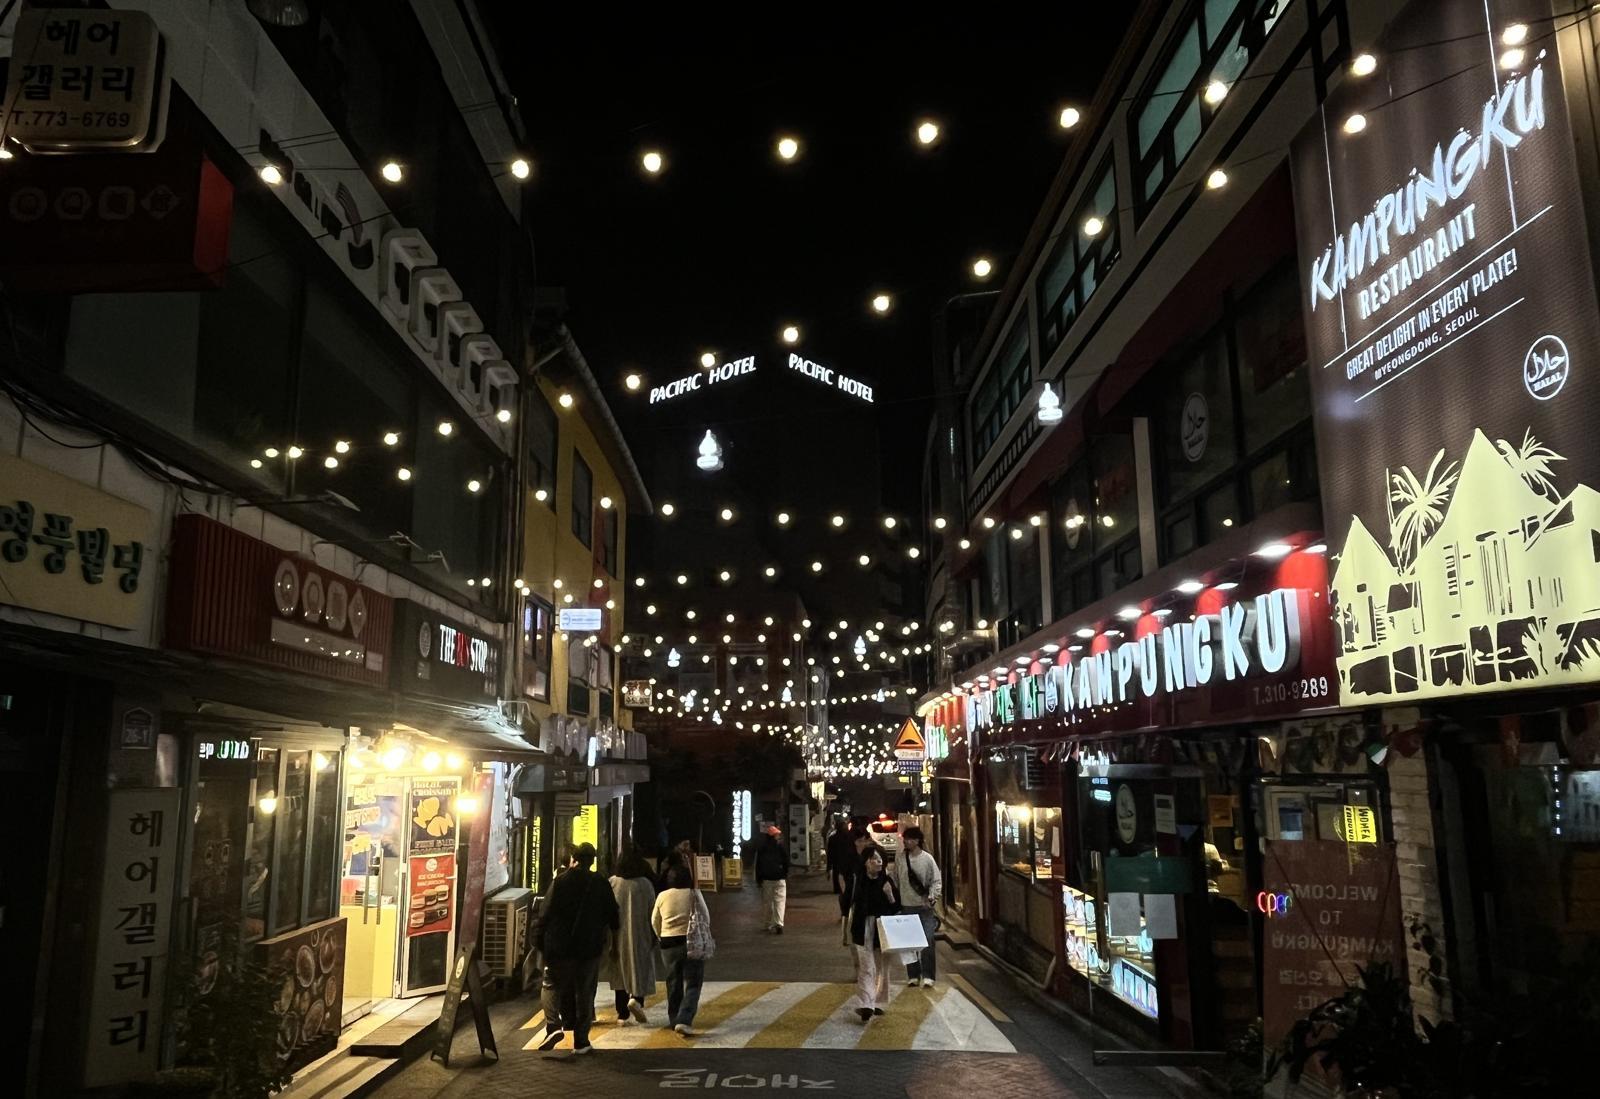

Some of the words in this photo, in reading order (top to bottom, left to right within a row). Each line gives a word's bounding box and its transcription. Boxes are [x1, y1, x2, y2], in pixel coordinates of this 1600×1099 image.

[46, 20, 120, 55] 헤어
[22, 64, 135, 101] 갤러리
[12, 110, 130, 127] T.773-6769
[1311, 52, 1547, 312] KAMPUNGKU
[1360, 203, 1476, 320] RESTAURANT
[1346, 345, 1375, 380] GREAT
[1376, 316, 1417, 361] DELIGHT
[1418, 307, 1431, 333] IN
[1431, 280, 1469, 324] EVERY
[1472, 248, 1518, 297] PLATE!
[1374, 331, 1443, 381] MYEONGDONG,
[1445, 306, 1480, 336] SEOUL
[650, 373, 702, 404] PACIFIC
[708, 355, 757, 385] HOTEL
[789, 353, 834, 386] PACIFIC
[838, 374, 874, 403] HOTEL
[1533, 371, 1564, 392] HALAL
[0, 500, 143, 594] 영풍빌딩
[440, 624, 457, 665] THE
[471, 637, 488, 674] STOP
[1063, 588, 1298, 713] KAMPUNGKU
